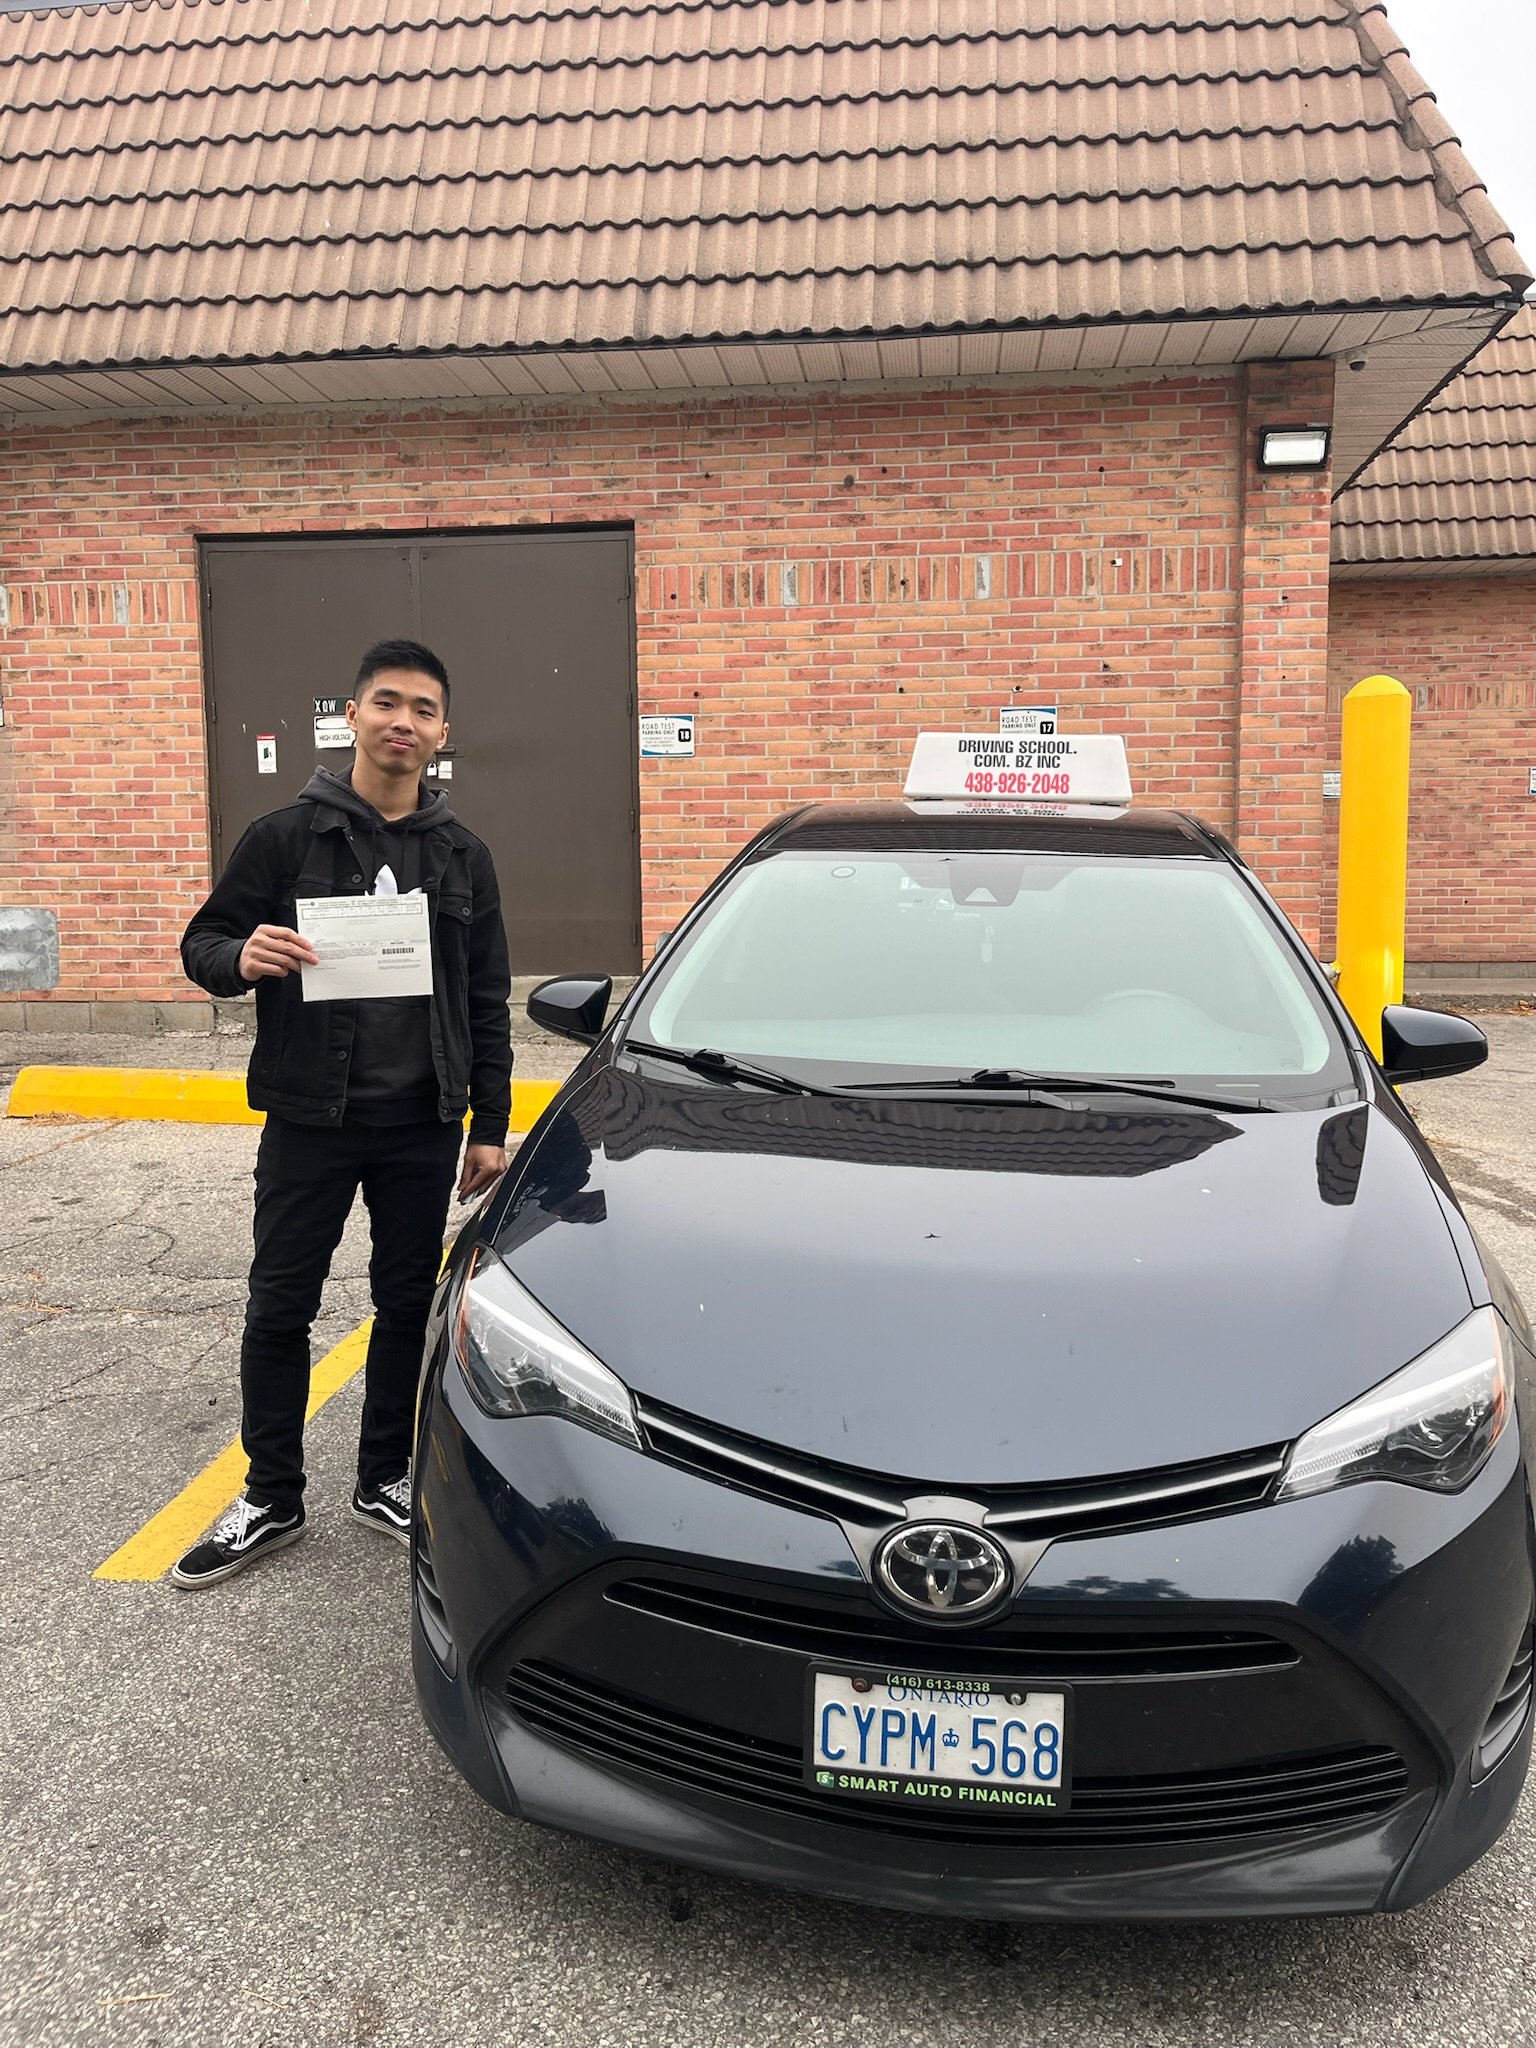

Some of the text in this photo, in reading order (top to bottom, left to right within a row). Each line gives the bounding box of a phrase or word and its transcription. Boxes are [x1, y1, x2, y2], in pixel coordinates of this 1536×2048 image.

[332, 733, 352, 741] VOLTAGE
[680, 731, 690, 740] 18
[1042, 723, 1053, 733] 17
[958, 739, 1077, 755] DRIVING SCHOOL.
[973, 754, 1061, 768] COM. BZ INC
[964, 772, 1070, 794] 438-926-2048
[886, 1673, 990, 1693] (416) 613-8338
[887, 1685, 990, 1709] ONTARIO
[822, 1702, 1059, 1780] CYPM 568
[838, 1775, 899, 1793] SMART
[904, 1782, 953, 1799] AUTO
[958, 1787, 1057, 1807] FINANCIAL
